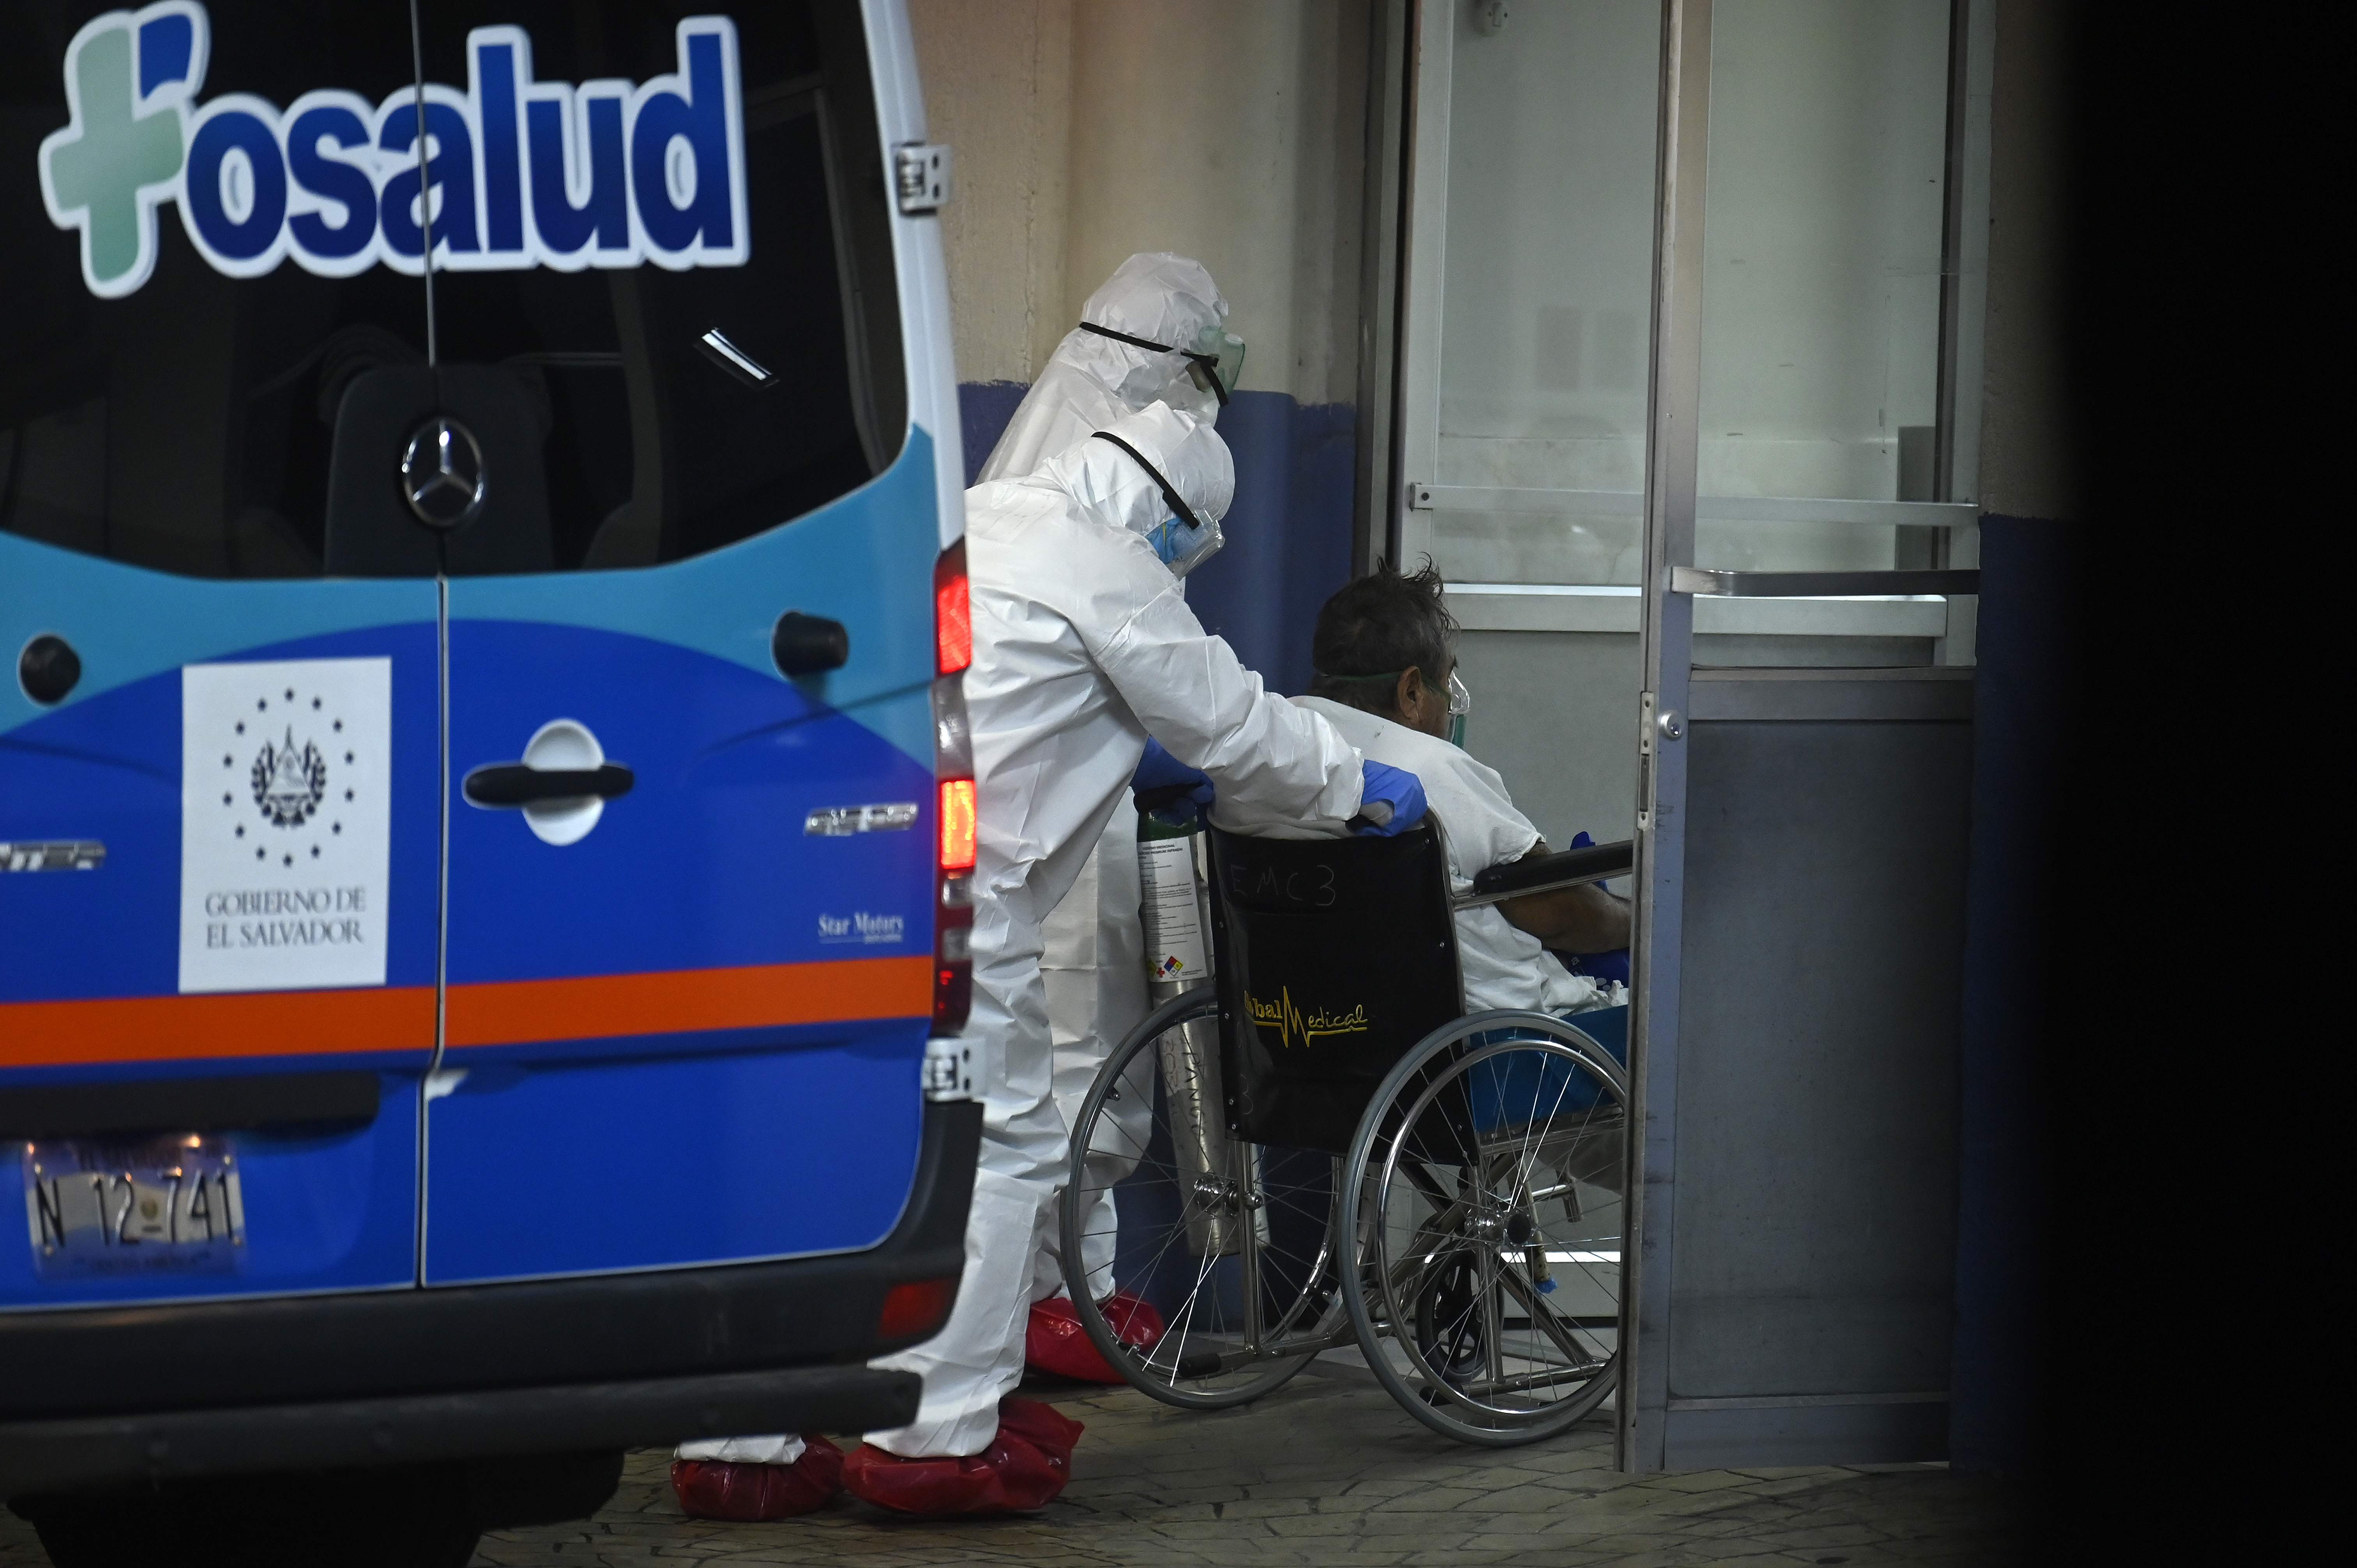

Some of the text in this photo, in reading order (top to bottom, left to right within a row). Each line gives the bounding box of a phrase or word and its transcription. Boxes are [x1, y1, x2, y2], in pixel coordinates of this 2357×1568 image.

[205, 885, 367, 918] GOBIERNO DE
[205, 917, 364, 949] EL SALVADOR
[818, 912, 904, 936] Star Motors
[1283, 985, 1368, 1048] Medical
[35, 1171, 65, 1247] N
